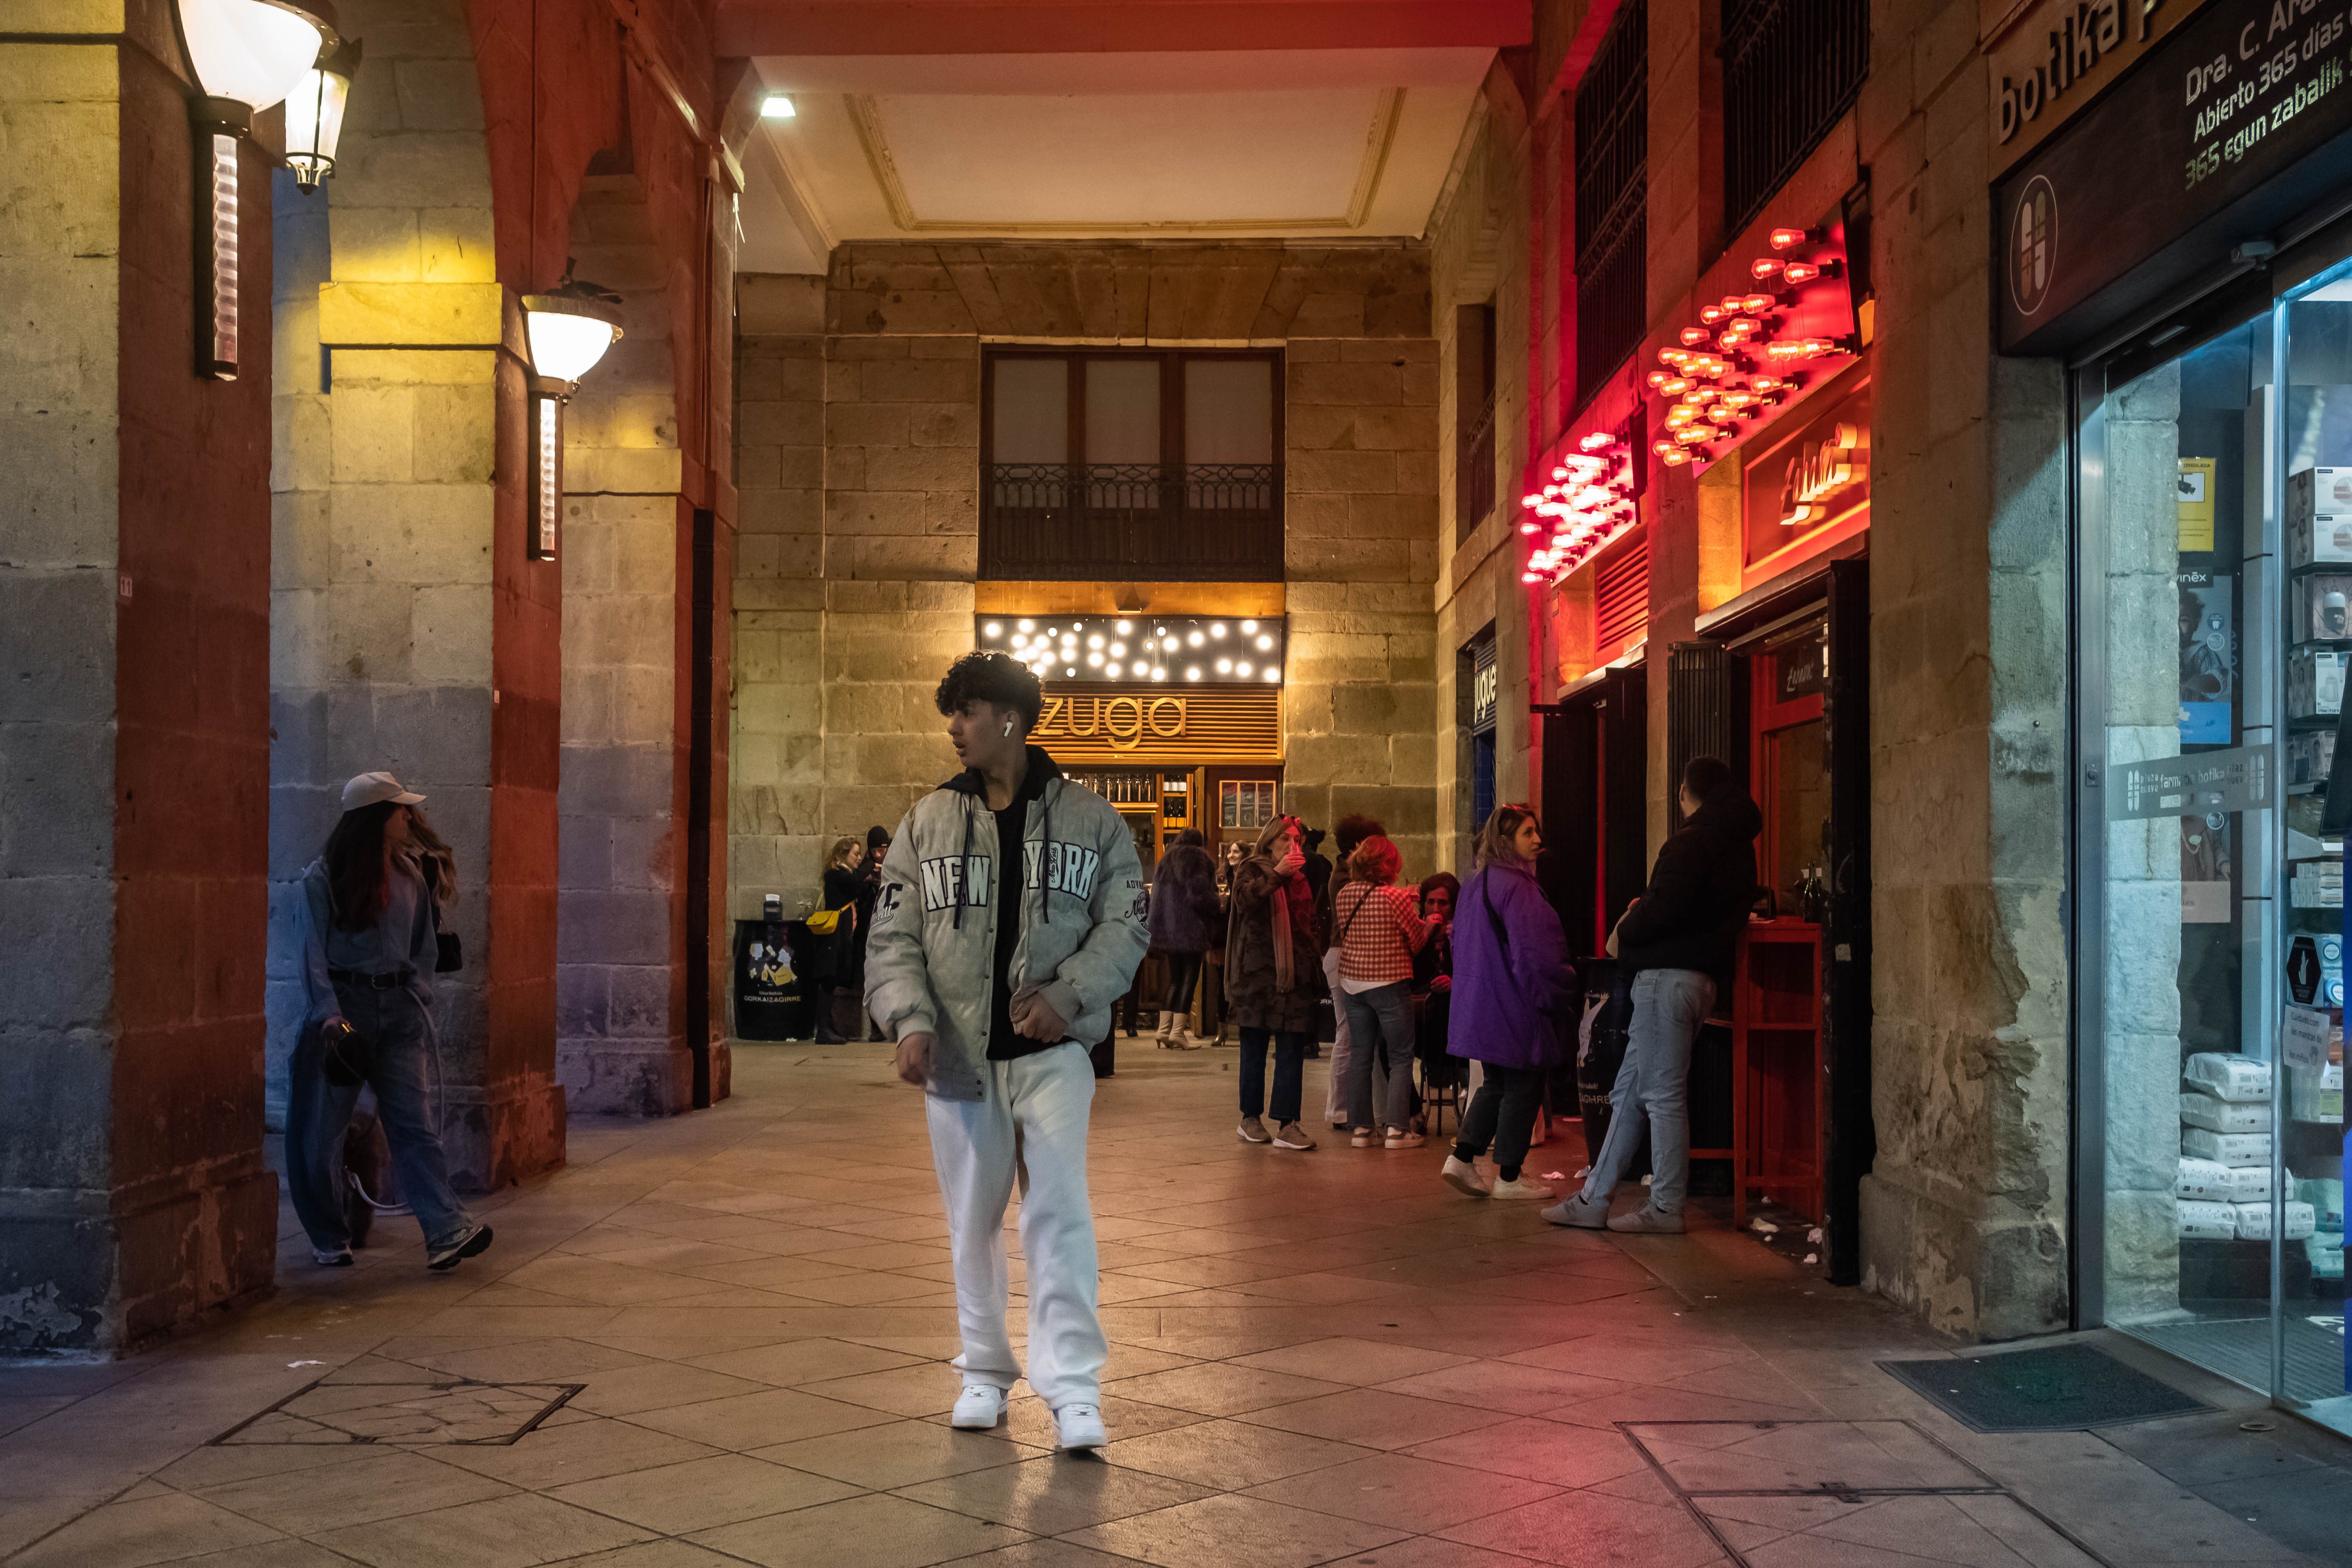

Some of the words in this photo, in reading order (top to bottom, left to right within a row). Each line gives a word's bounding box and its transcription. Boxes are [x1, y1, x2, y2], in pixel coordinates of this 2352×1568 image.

[1999, 0, 2123, 146] botika
[2185, 54, 2232, 106] Dra.
[2239, 20, 2260, 61] C.
[2194, 80, 2255, 143] Abierto
[2259, 40, 2297, 95] 365
[2302, 12, 2343, 61] días
[2185, 141, 2220, 191] 365
[2224, 115, 2267, 164] egun
[2271, 56, 2343, 131] zabalik
[121, 579, 131, 595] 11
[1037, 697, 1186, 749] zuga
[1474, 661, 1497, 724] jugue
[920, 855, 991, 912] NEW
[1023, 839, 1099, 902] YORK
[2291, 1012, 2309, 1024] Cuidado
[2310, 1019, 2319, 1028] con
[2298, 1030, 2316, 1041] manitas
[2296, 1053, 2309, 1064] niños
